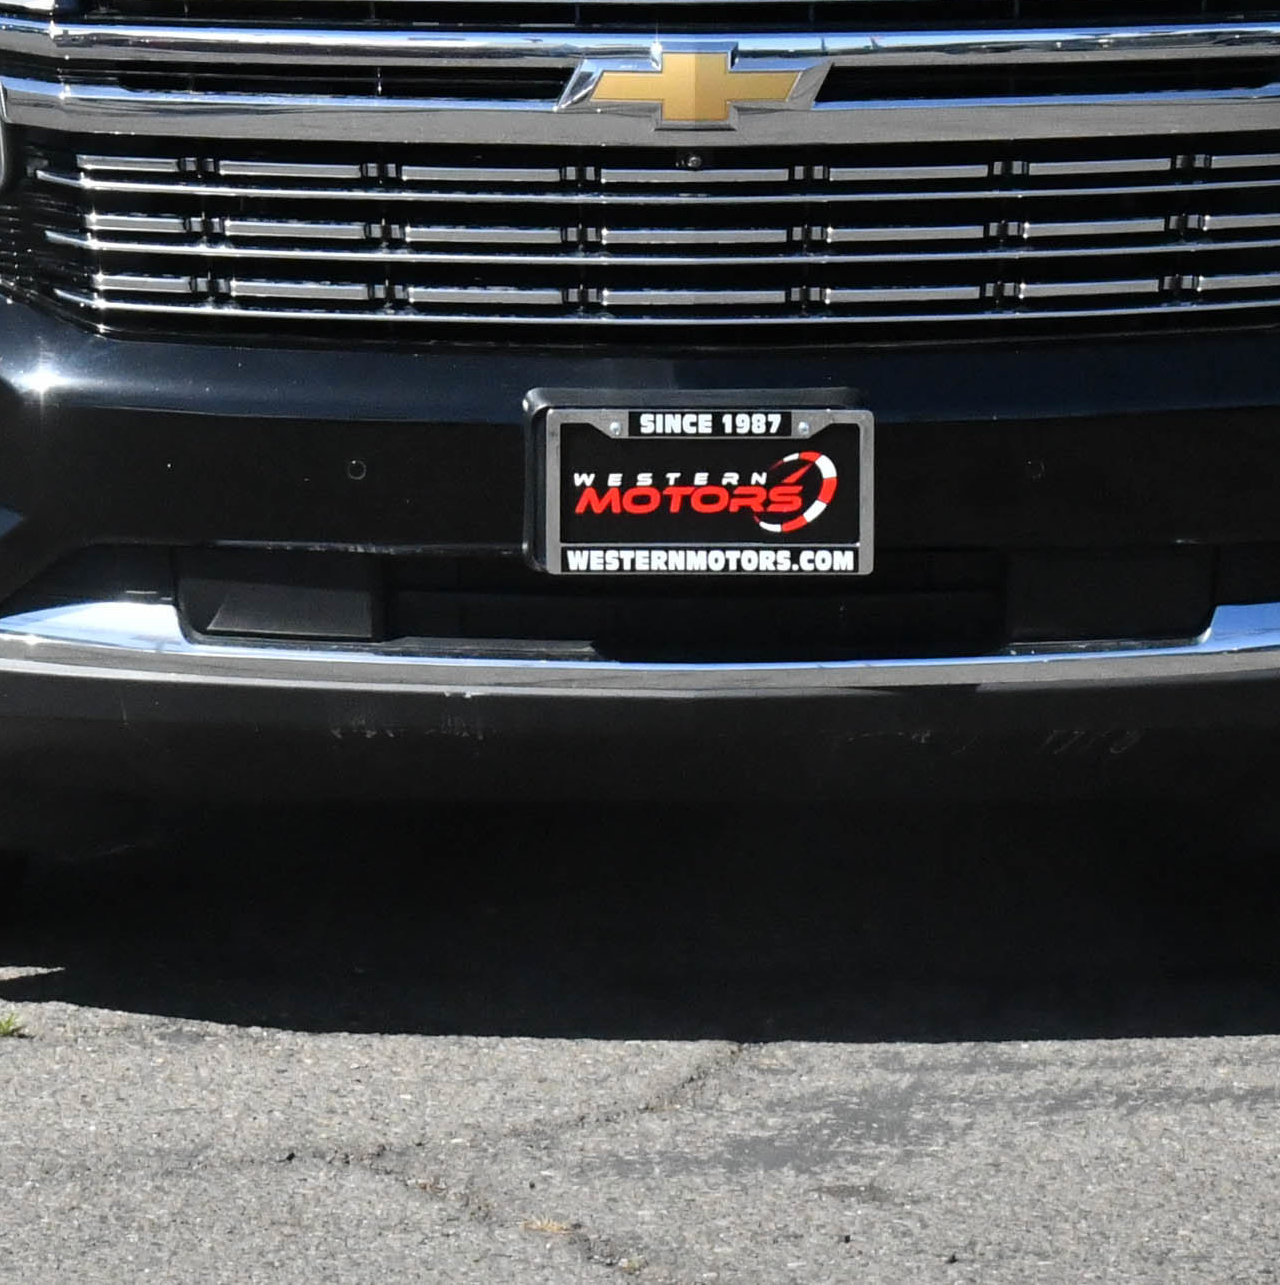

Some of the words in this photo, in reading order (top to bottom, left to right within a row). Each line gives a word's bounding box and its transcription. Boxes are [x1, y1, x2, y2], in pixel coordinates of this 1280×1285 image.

[639, 413, 713, 434] SINCE
[722, 413, 782, 434] 1987
[573, 472, 768, 487] WESTERN
[574, 485, 804, 515] MOTORS
[566, 549, 855, 572] WESTERNMOTORS.COM
